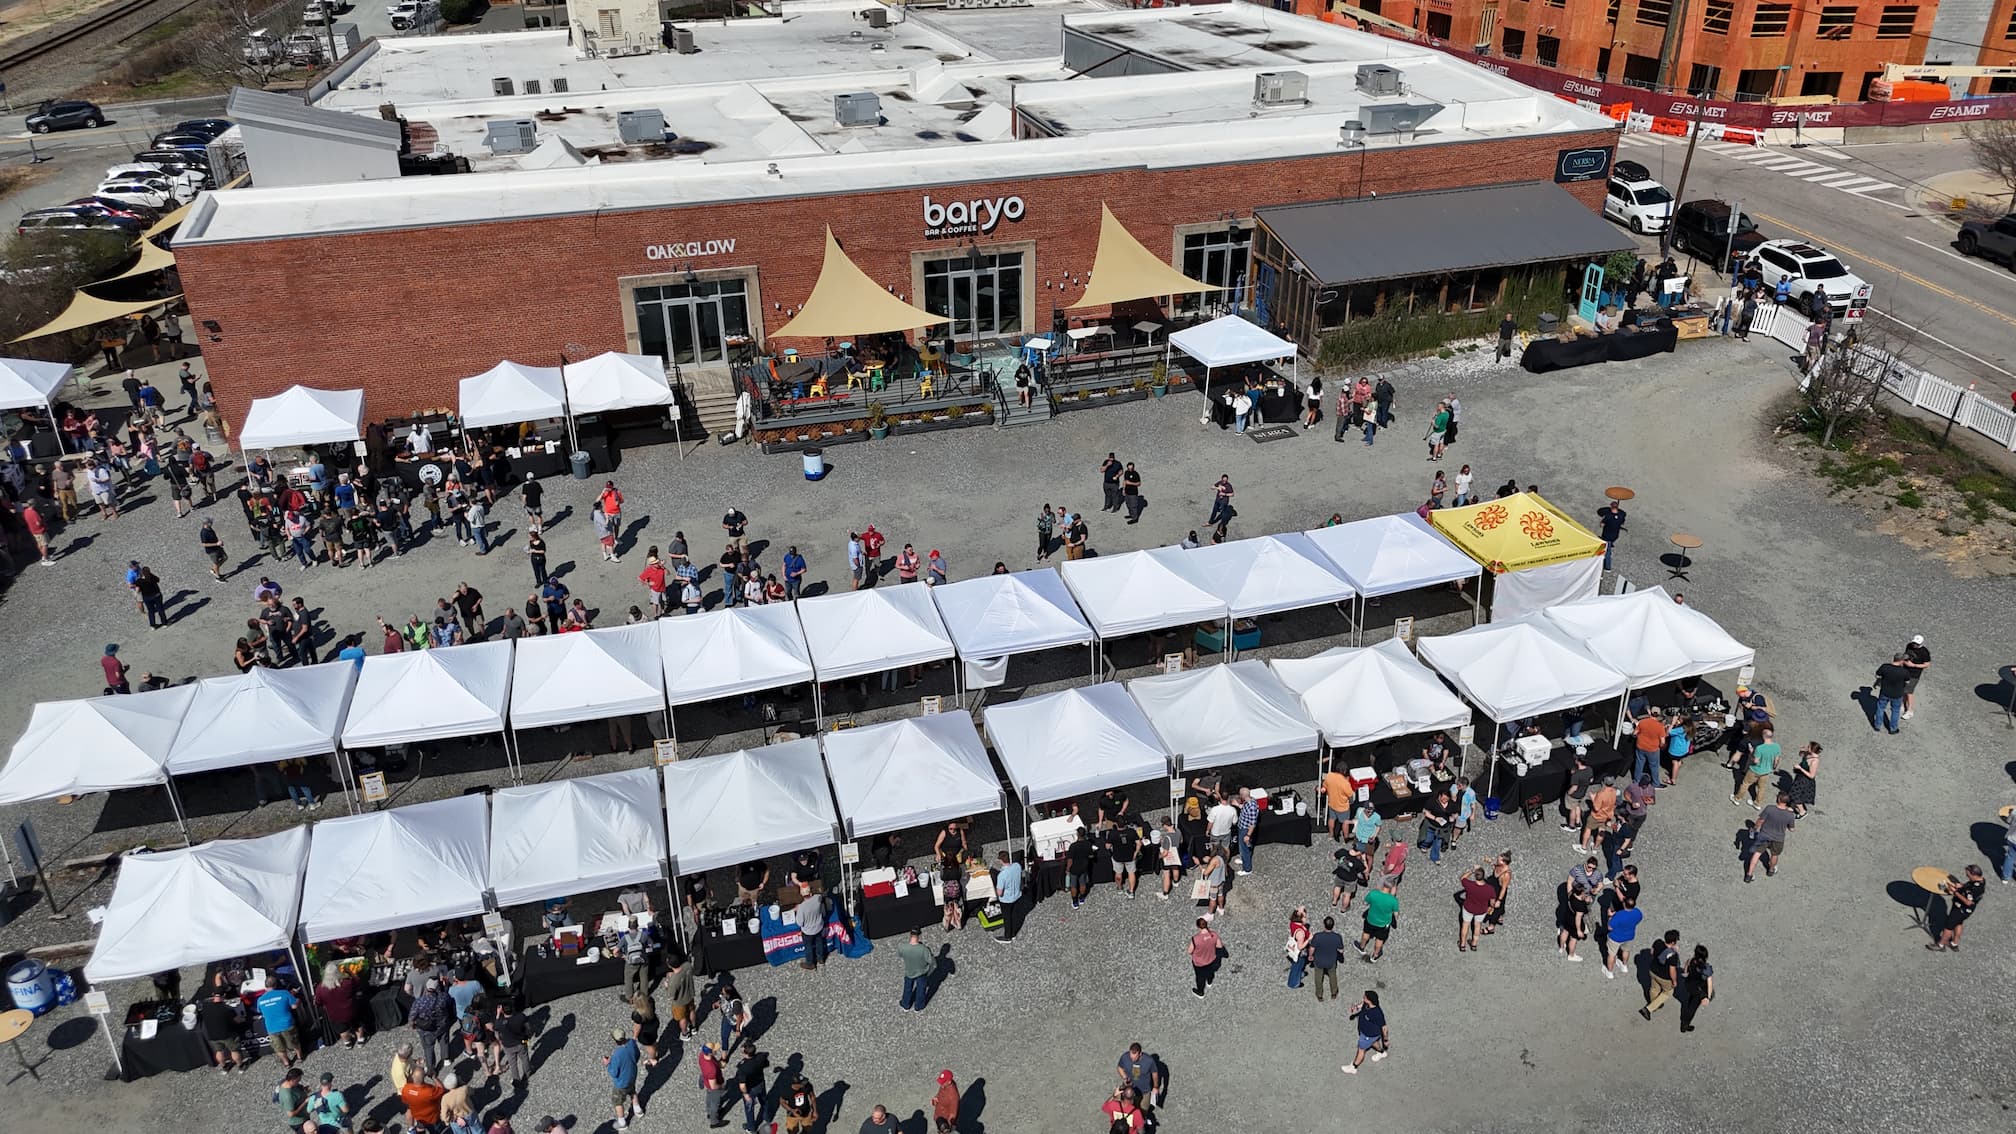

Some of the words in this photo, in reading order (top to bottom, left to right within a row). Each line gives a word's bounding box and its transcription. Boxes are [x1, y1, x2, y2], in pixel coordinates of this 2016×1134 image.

[1486, 62, 1510, 76] SAMET
[1574, 82, 1602, 98] SAMET
[1685, 104, 1727, 118] SAMET
[1787, 111, 1833, 122] SMET
[1947, 104, 1990, 117] SAMET
[923, 195, 1025, 230] baryo
[924, 228, 940, 236] BAR
[947, 224, 978, 234] COFFEE
[14, 983, 42, 997] FINA
